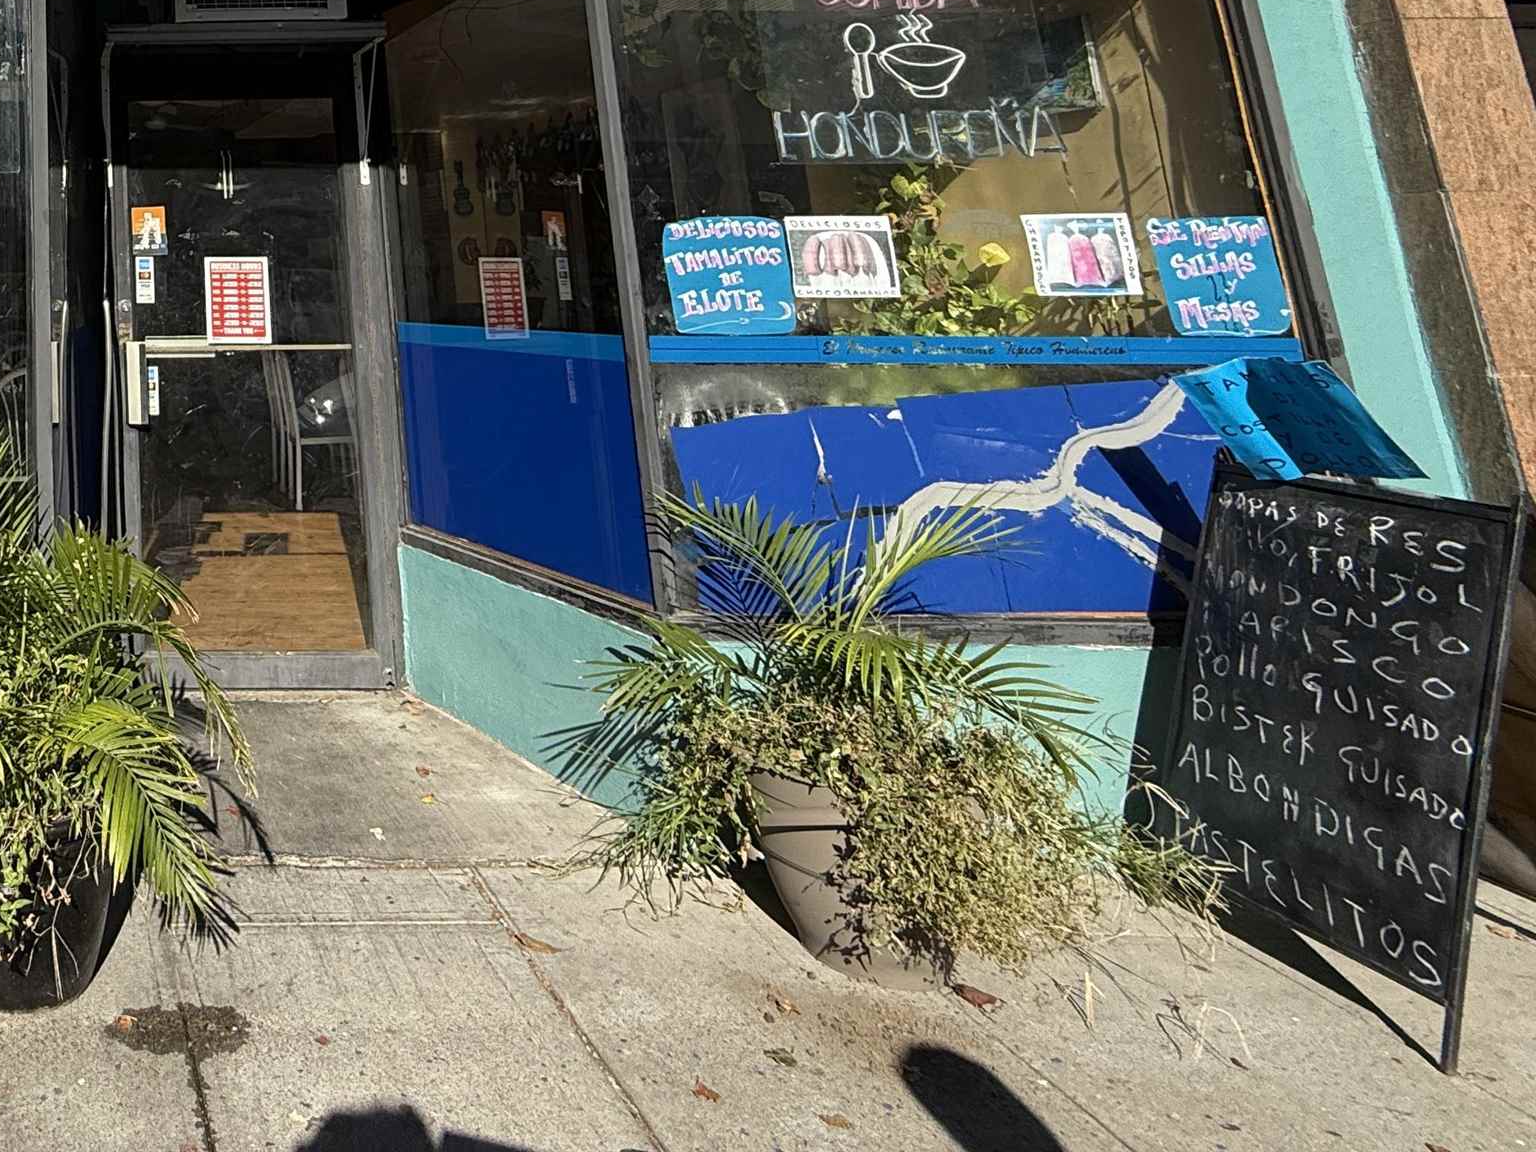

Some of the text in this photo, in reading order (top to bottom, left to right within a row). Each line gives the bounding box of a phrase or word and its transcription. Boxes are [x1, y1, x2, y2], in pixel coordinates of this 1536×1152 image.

[677, 288, 765, 318] ELOTE
[718, 271, 744, 286] DE
[1173, 296, 1260, 329] MESAS
[1368, 515, 1467, 572] RES
[1301, 672, 1473, 755] GUISADO
[1191, 684, 1465, 831] BISTEK GUISADO
[1178, 741, 1452, 905] ALBONDIGAS
